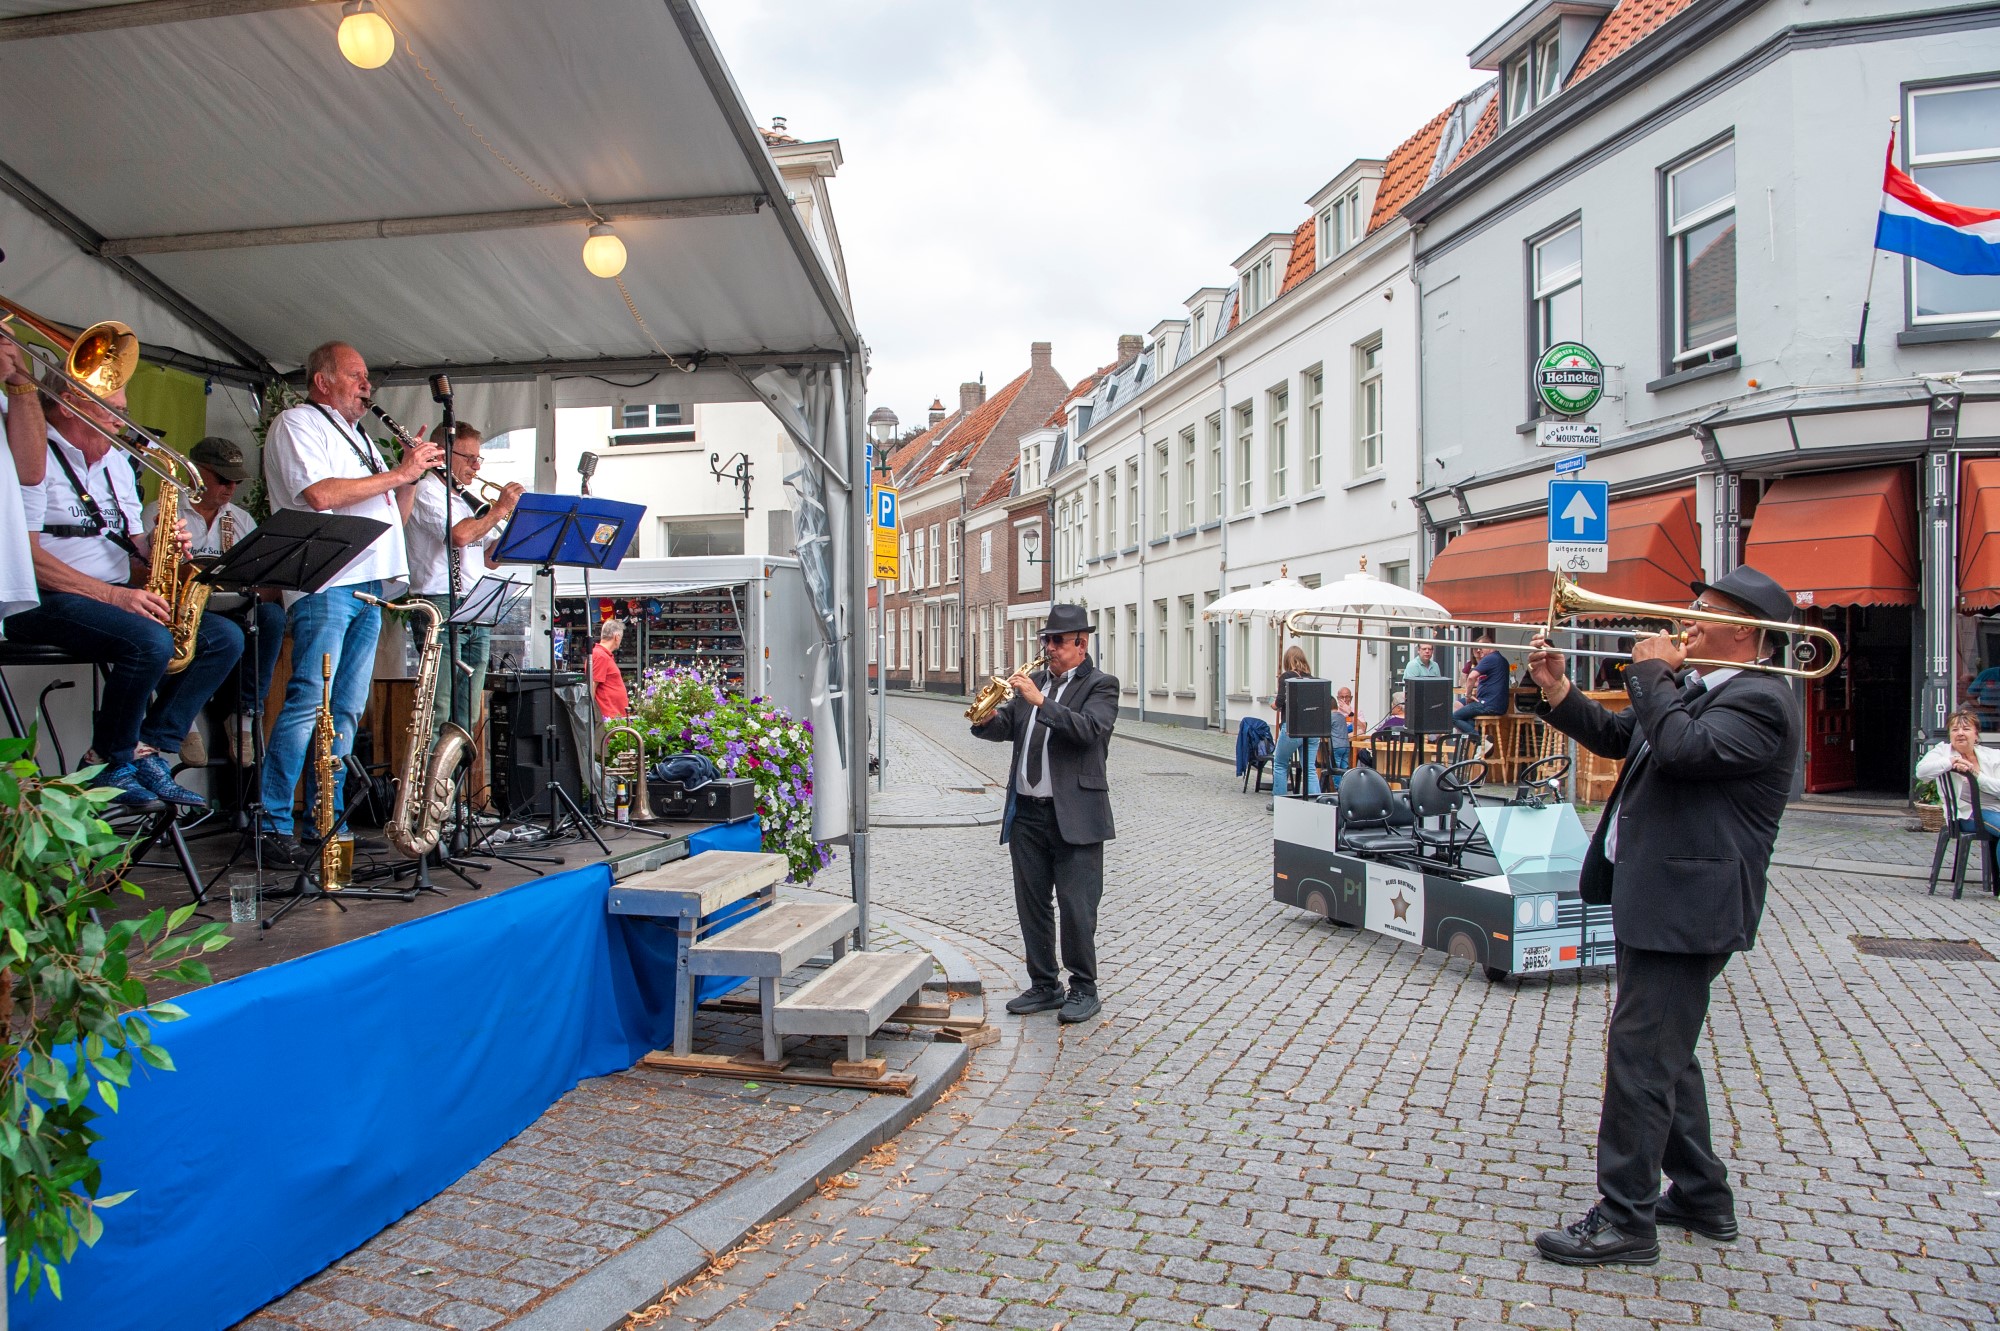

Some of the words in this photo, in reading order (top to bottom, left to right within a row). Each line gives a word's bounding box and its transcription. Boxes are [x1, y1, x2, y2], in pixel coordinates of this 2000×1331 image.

[1545, 372, 1599, 384] Heineken
[1550, 391, 1574, 408] PREMIUM
[1576, 392, 1595, 408] QUALITY
[1556, 435, 1599, 443] MOUSTACHE
[1343, 878, 1362, 907] P1
